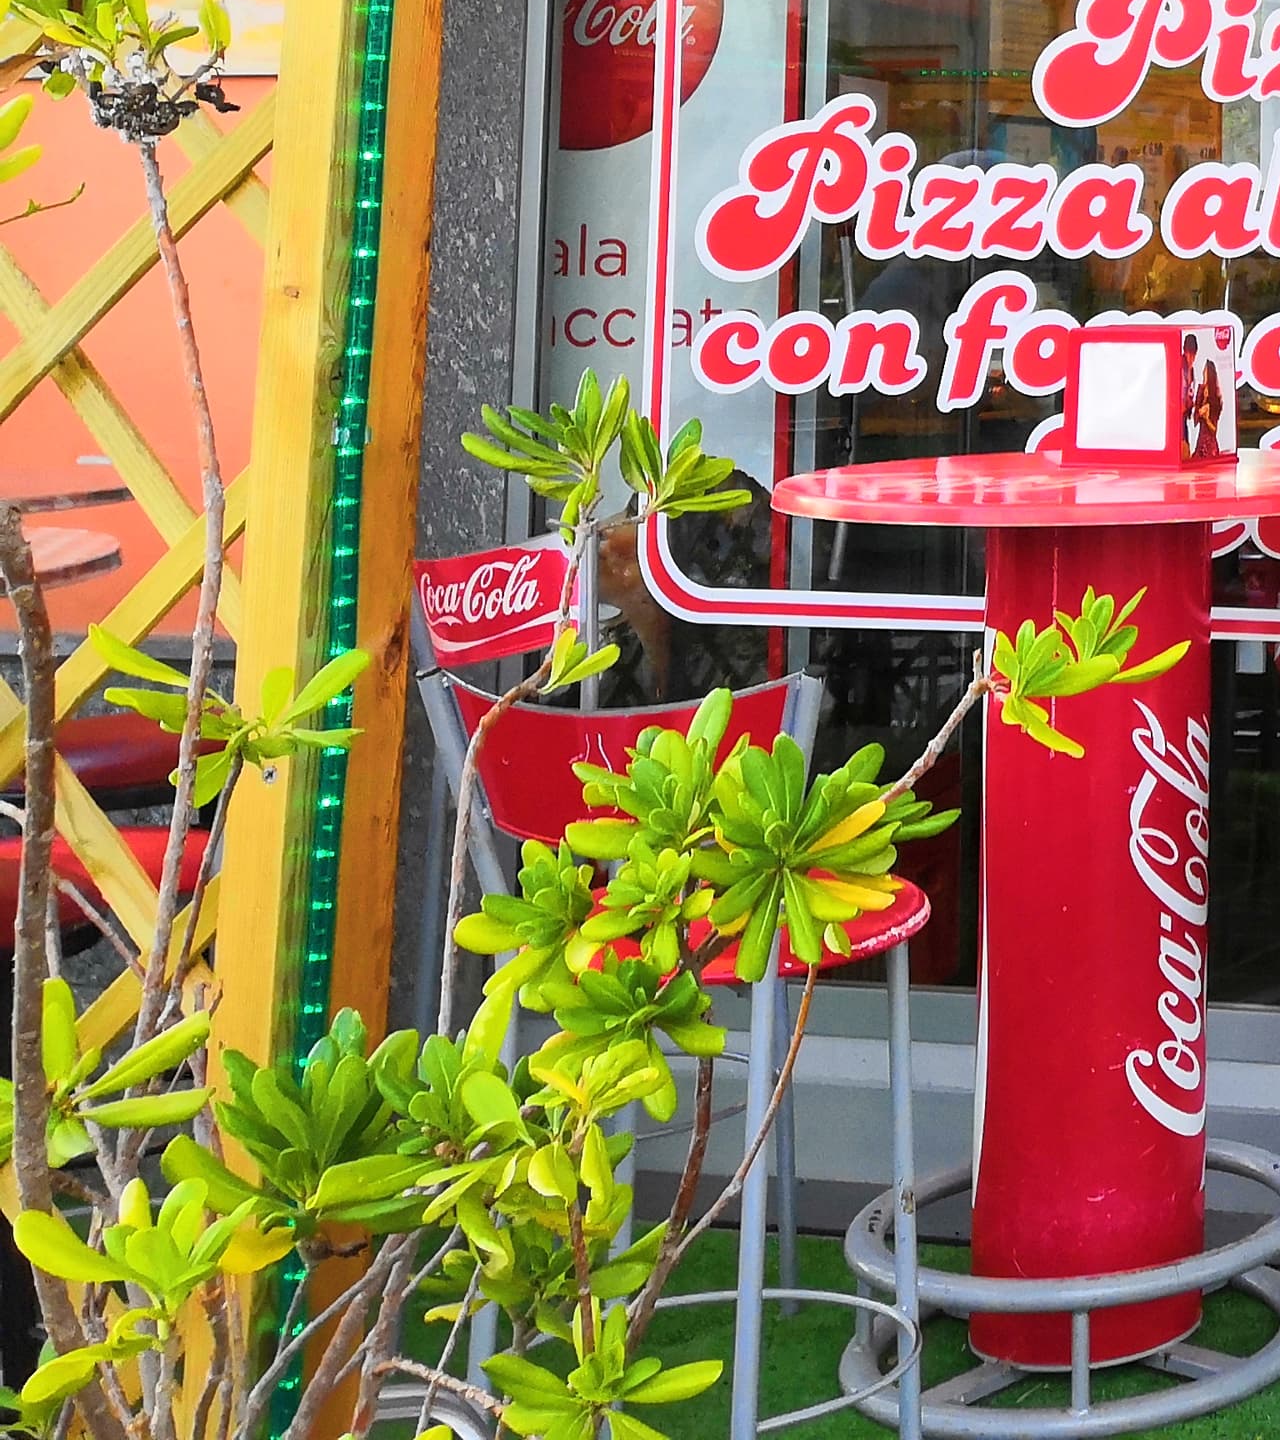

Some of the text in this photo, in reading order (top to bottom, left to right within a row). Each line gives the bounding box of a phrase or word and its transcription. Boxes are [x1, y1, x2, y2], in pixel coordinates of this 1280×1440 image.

[697, 95, 1152, 281] Pizza
[694, 312, 925, 395] con
[420, 552, 542, 626] Coca-Cola
[1126, 699, 1209, 1136] Coca-Cola
